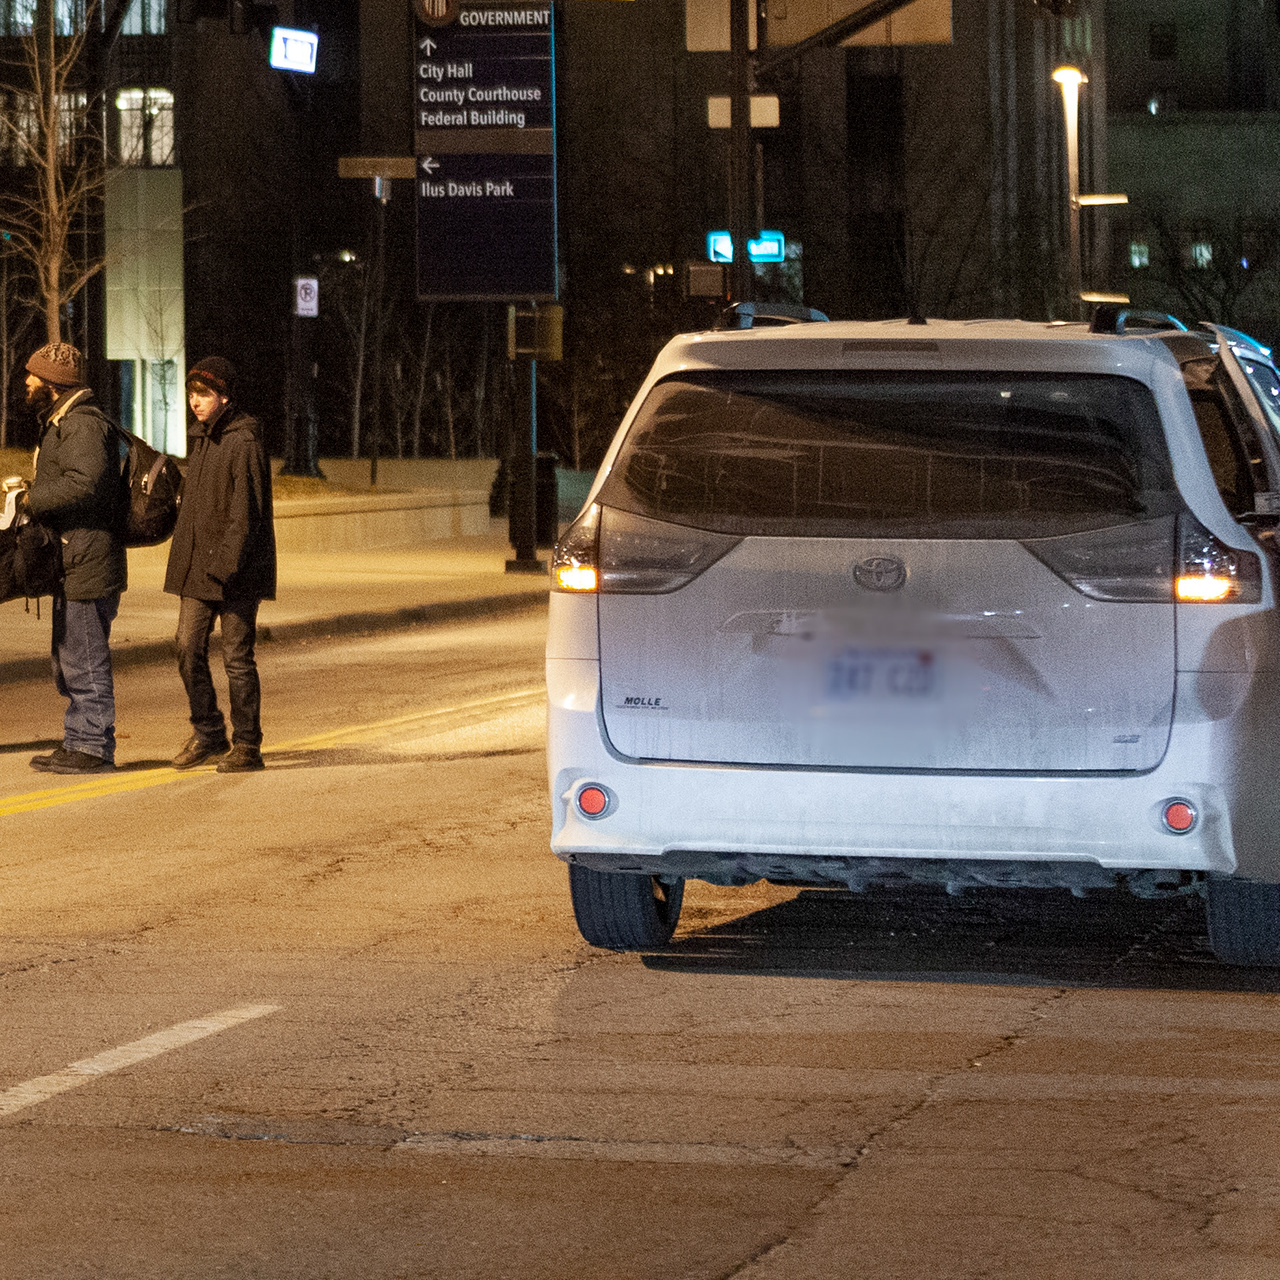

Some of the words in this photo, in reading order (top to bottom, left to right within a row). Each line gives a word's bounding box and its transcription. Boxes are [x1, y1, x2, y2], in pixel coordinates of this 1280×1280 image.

[460, 10, 550, 26] GOVERNMENT
[419, 63, 444, 82] City
[447, 62, 473, 78] Hall
[420, 87, 465, 105] County
[468, 86, 541, 101] Courthouse
[421, 110, 467, 125] Federal
[471, 109, 525, 128] Building
[422, 181, 445, 197] Ilus
[448, 181, 483, 197] Davis
[486, 180, 514, 196] Park
[624, 696, 661, 706] MOLLE
